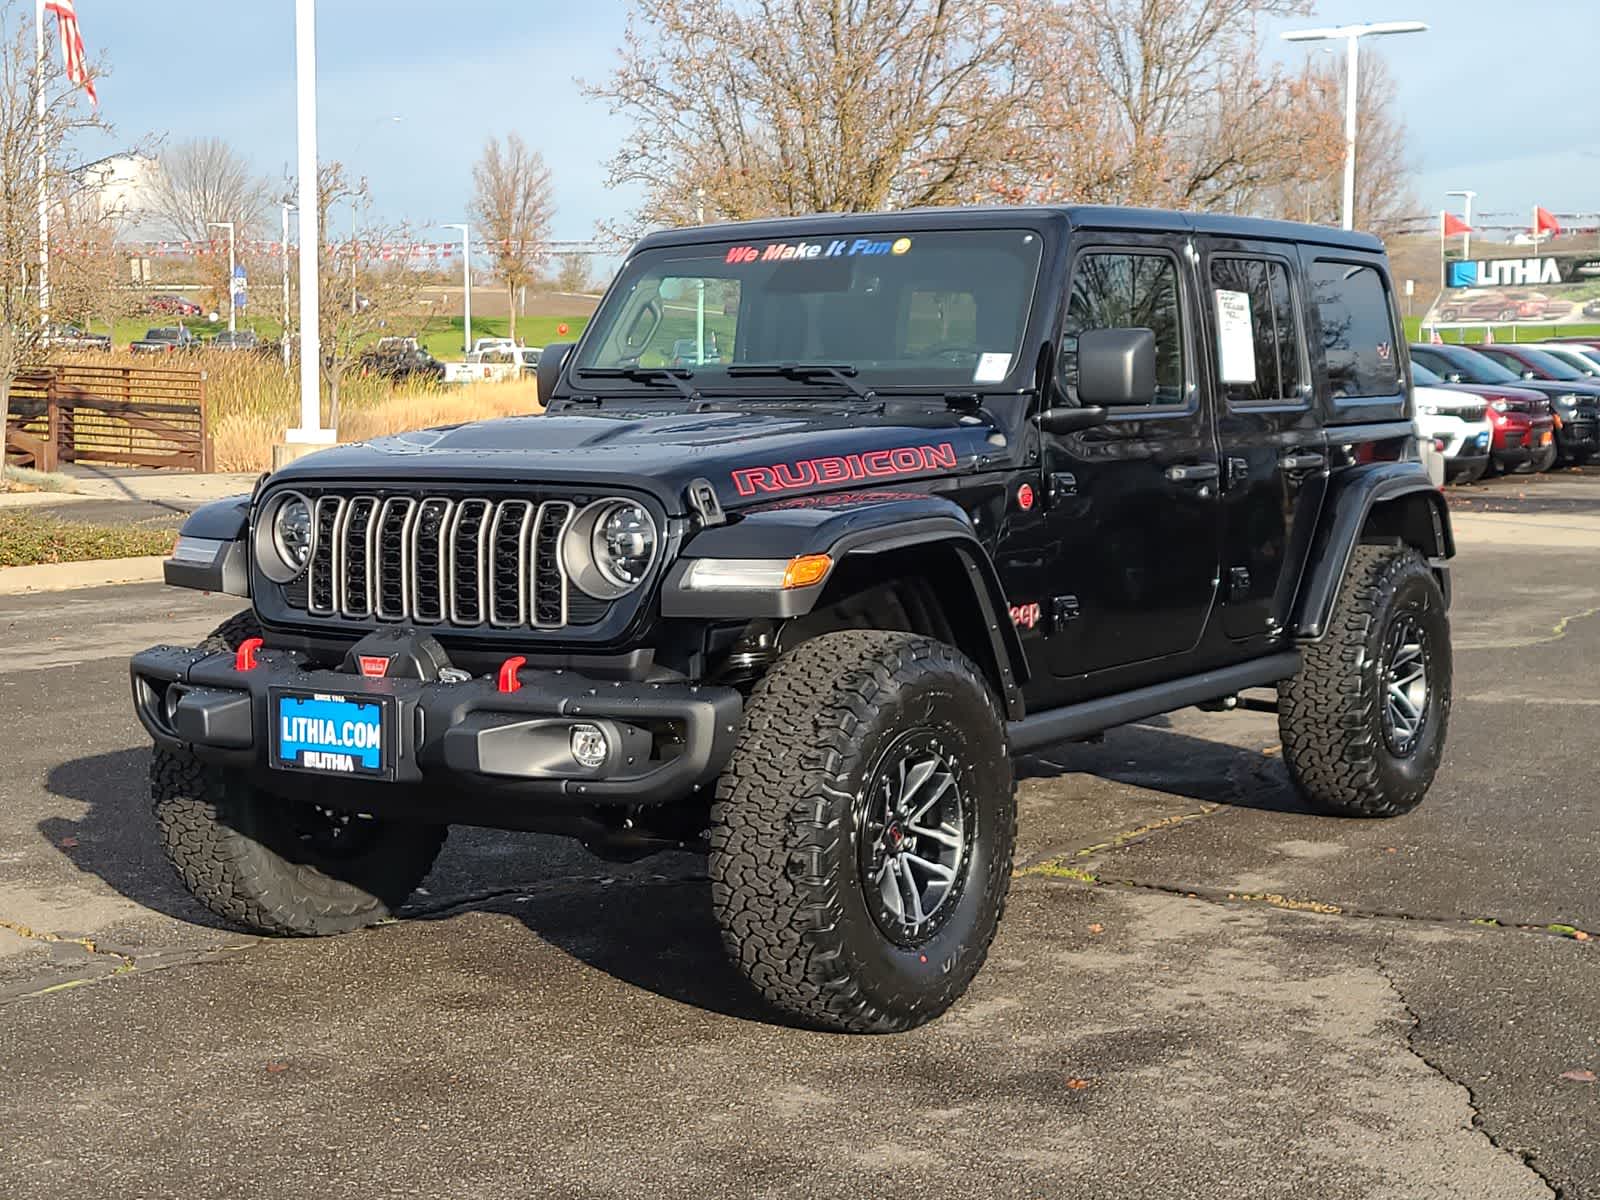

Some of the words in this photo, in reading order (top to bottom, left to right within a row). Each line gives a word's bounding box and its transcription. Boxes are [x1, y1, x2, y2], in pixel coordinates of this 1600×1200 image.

[726, 246, 759, 263] We
[762, 242, 821, 260] Make
[825, 240, 848, 257] It
[849, 239, 892, 256] Fun
[1477, 257, 1562, 286] LITHIA
[732, 443, 958, 496] RUBICON
[1008, 603, 1040, 629] eep
[282, 716, 380, 749] LITHIA.COM
[315, 752, 354, 772] LITHIA
